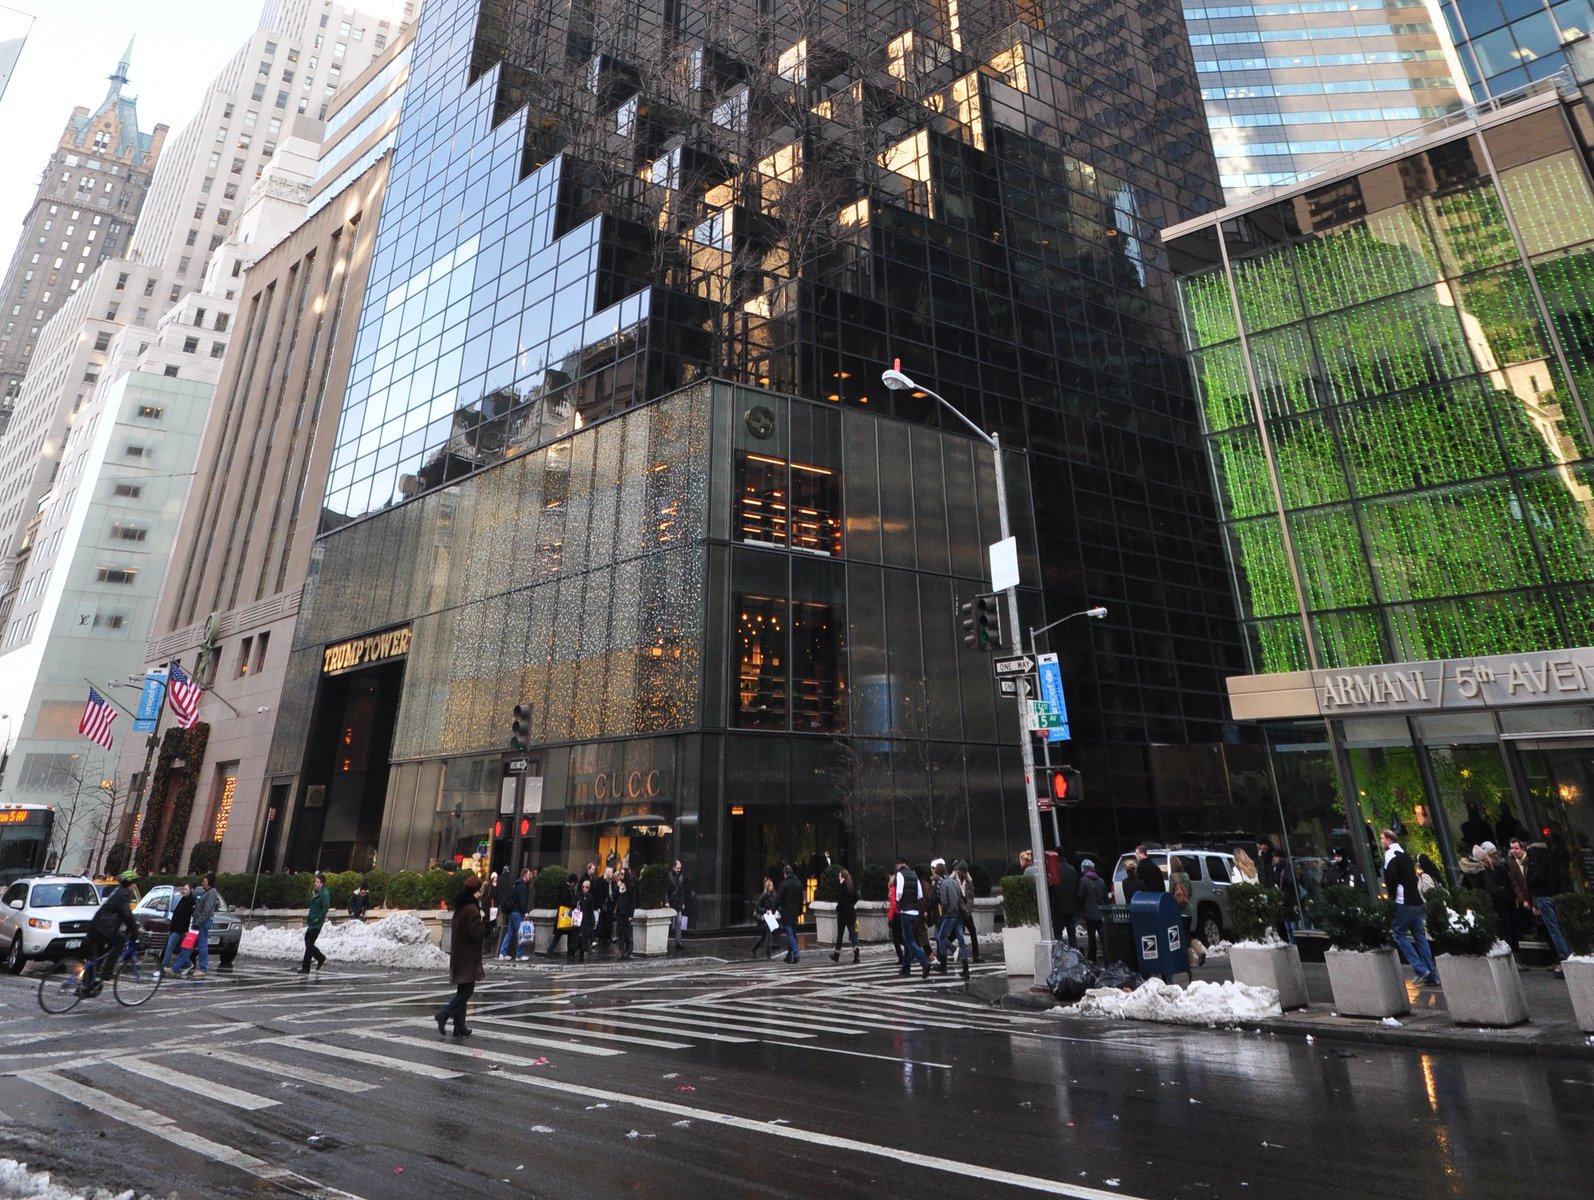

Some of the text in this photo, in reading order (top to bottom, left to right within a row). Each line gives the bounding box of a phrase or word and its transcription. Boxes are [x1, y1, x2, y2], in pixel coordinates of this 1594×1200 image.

[323, 628, 409, 672] TRUMP TOWER
[1000, 660, 1030, 671] ONE WAY
[1323, 669, 1429, 706] ARMANI
[1456, 665, 1496, 698] 5th
[1041, 715, 1048, 728] 5
[9, 810, 16, 822] 5
[16, 810, 28, 822] AV
